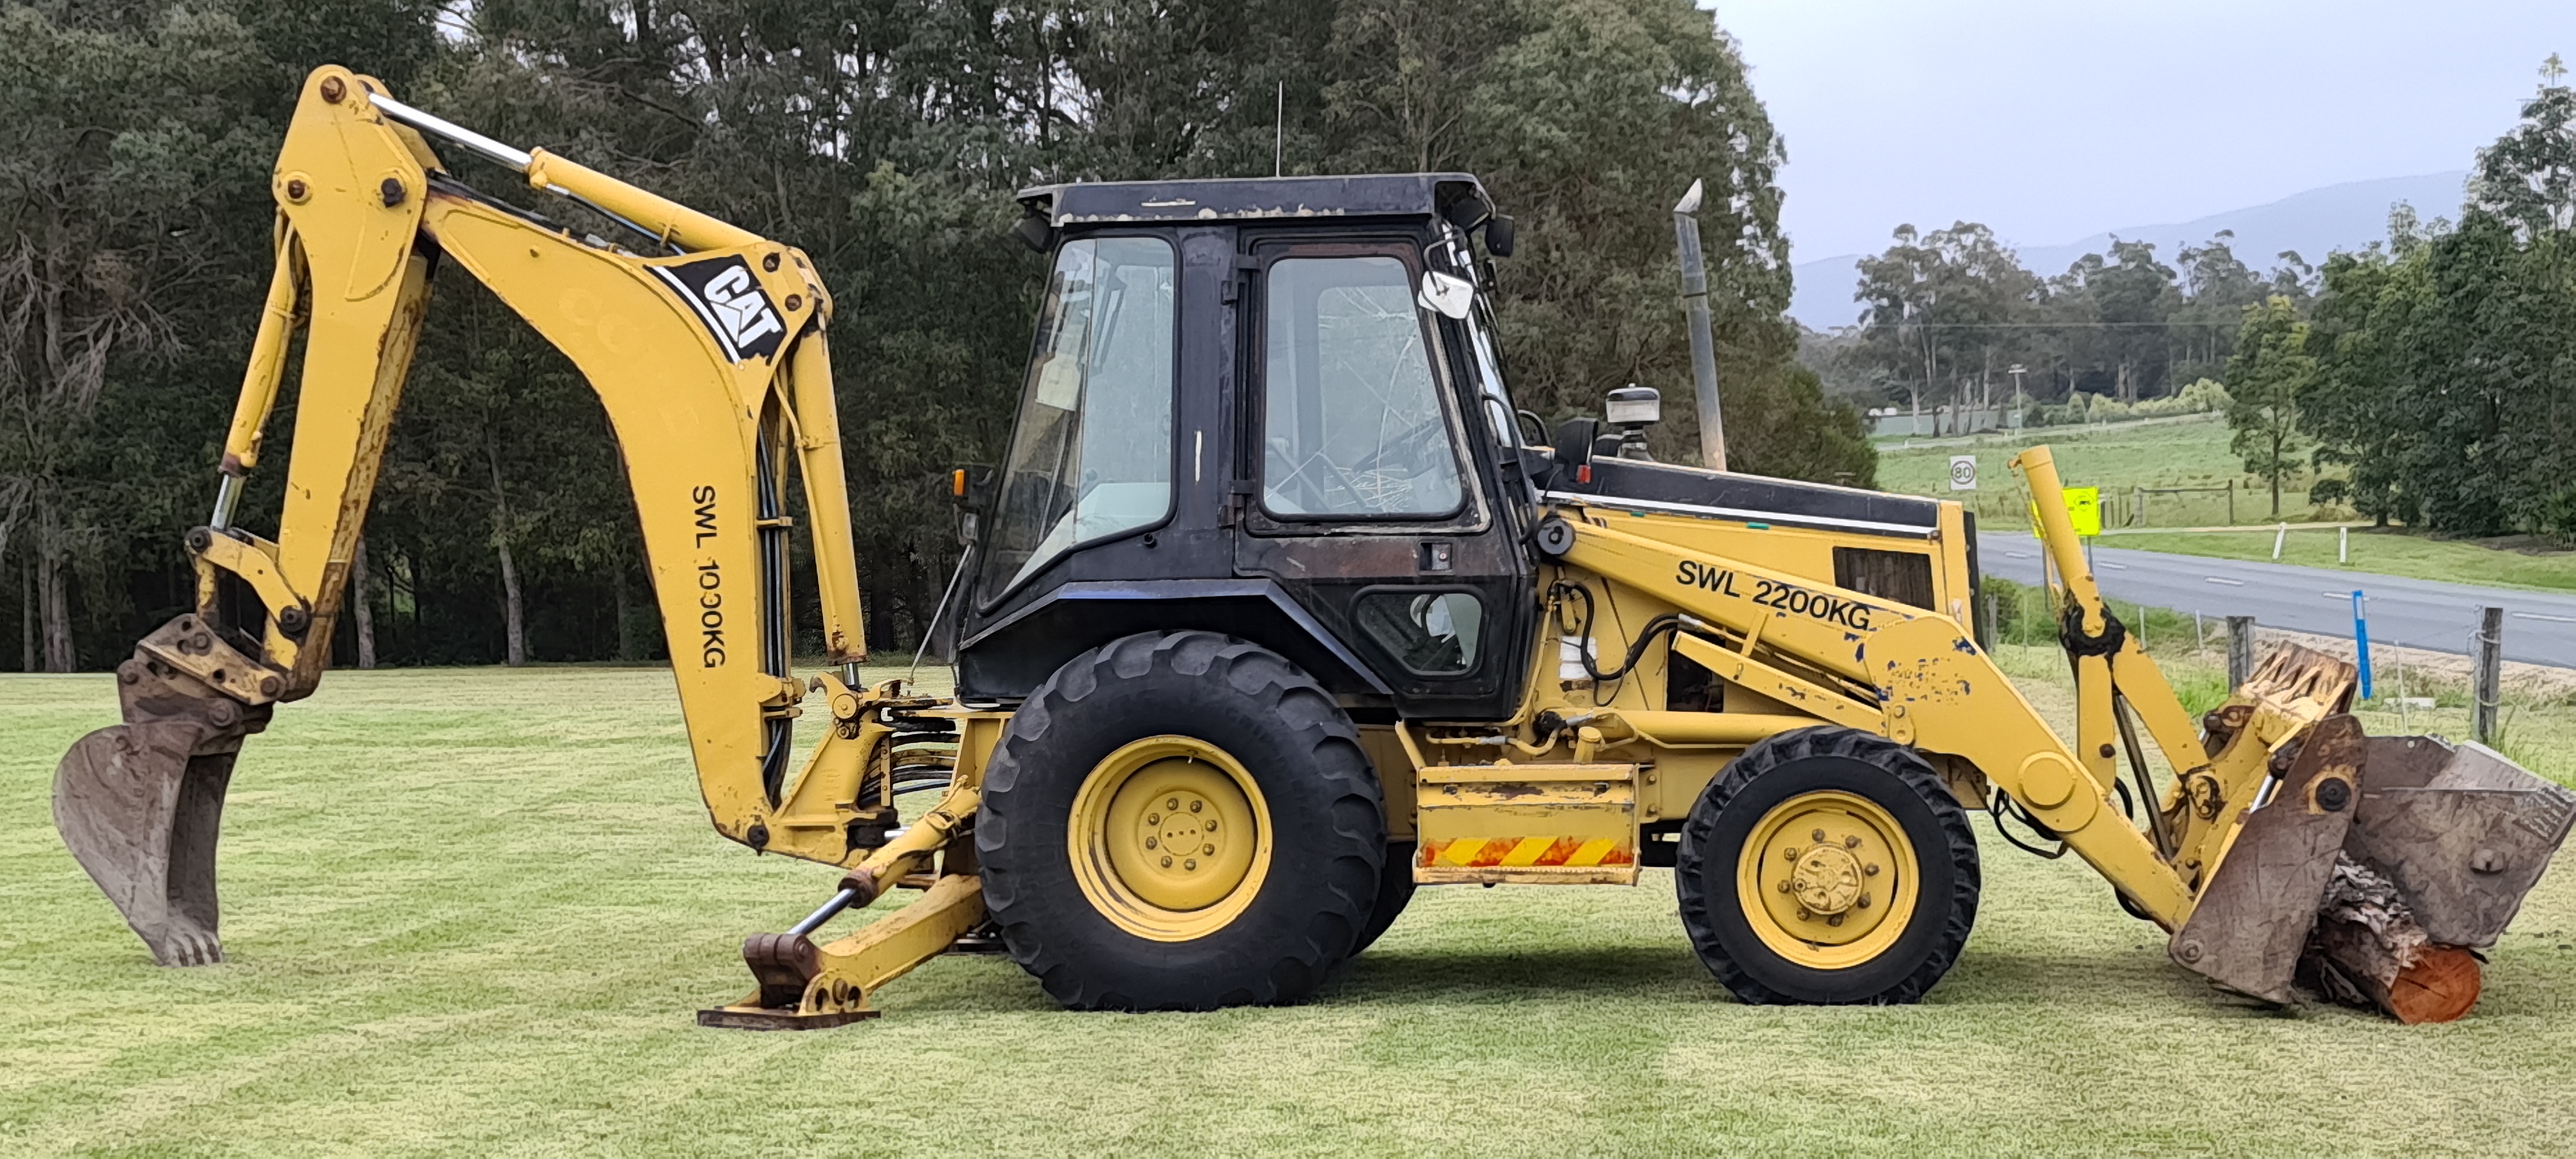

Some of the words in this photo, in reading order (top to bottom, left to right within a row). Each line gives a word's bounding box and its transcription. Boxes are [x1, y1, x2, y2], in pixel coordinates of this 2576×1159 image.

[704, 265, 782, 348] CAT
[1955, 467, 1971, 478] 80
[692, 485, 717, 549] SWL
[698, 559, 725, 668] 1000KG
[1676, 560, 1740, 598] SWL
[1752, 580, 1871, 631] 2200KG
